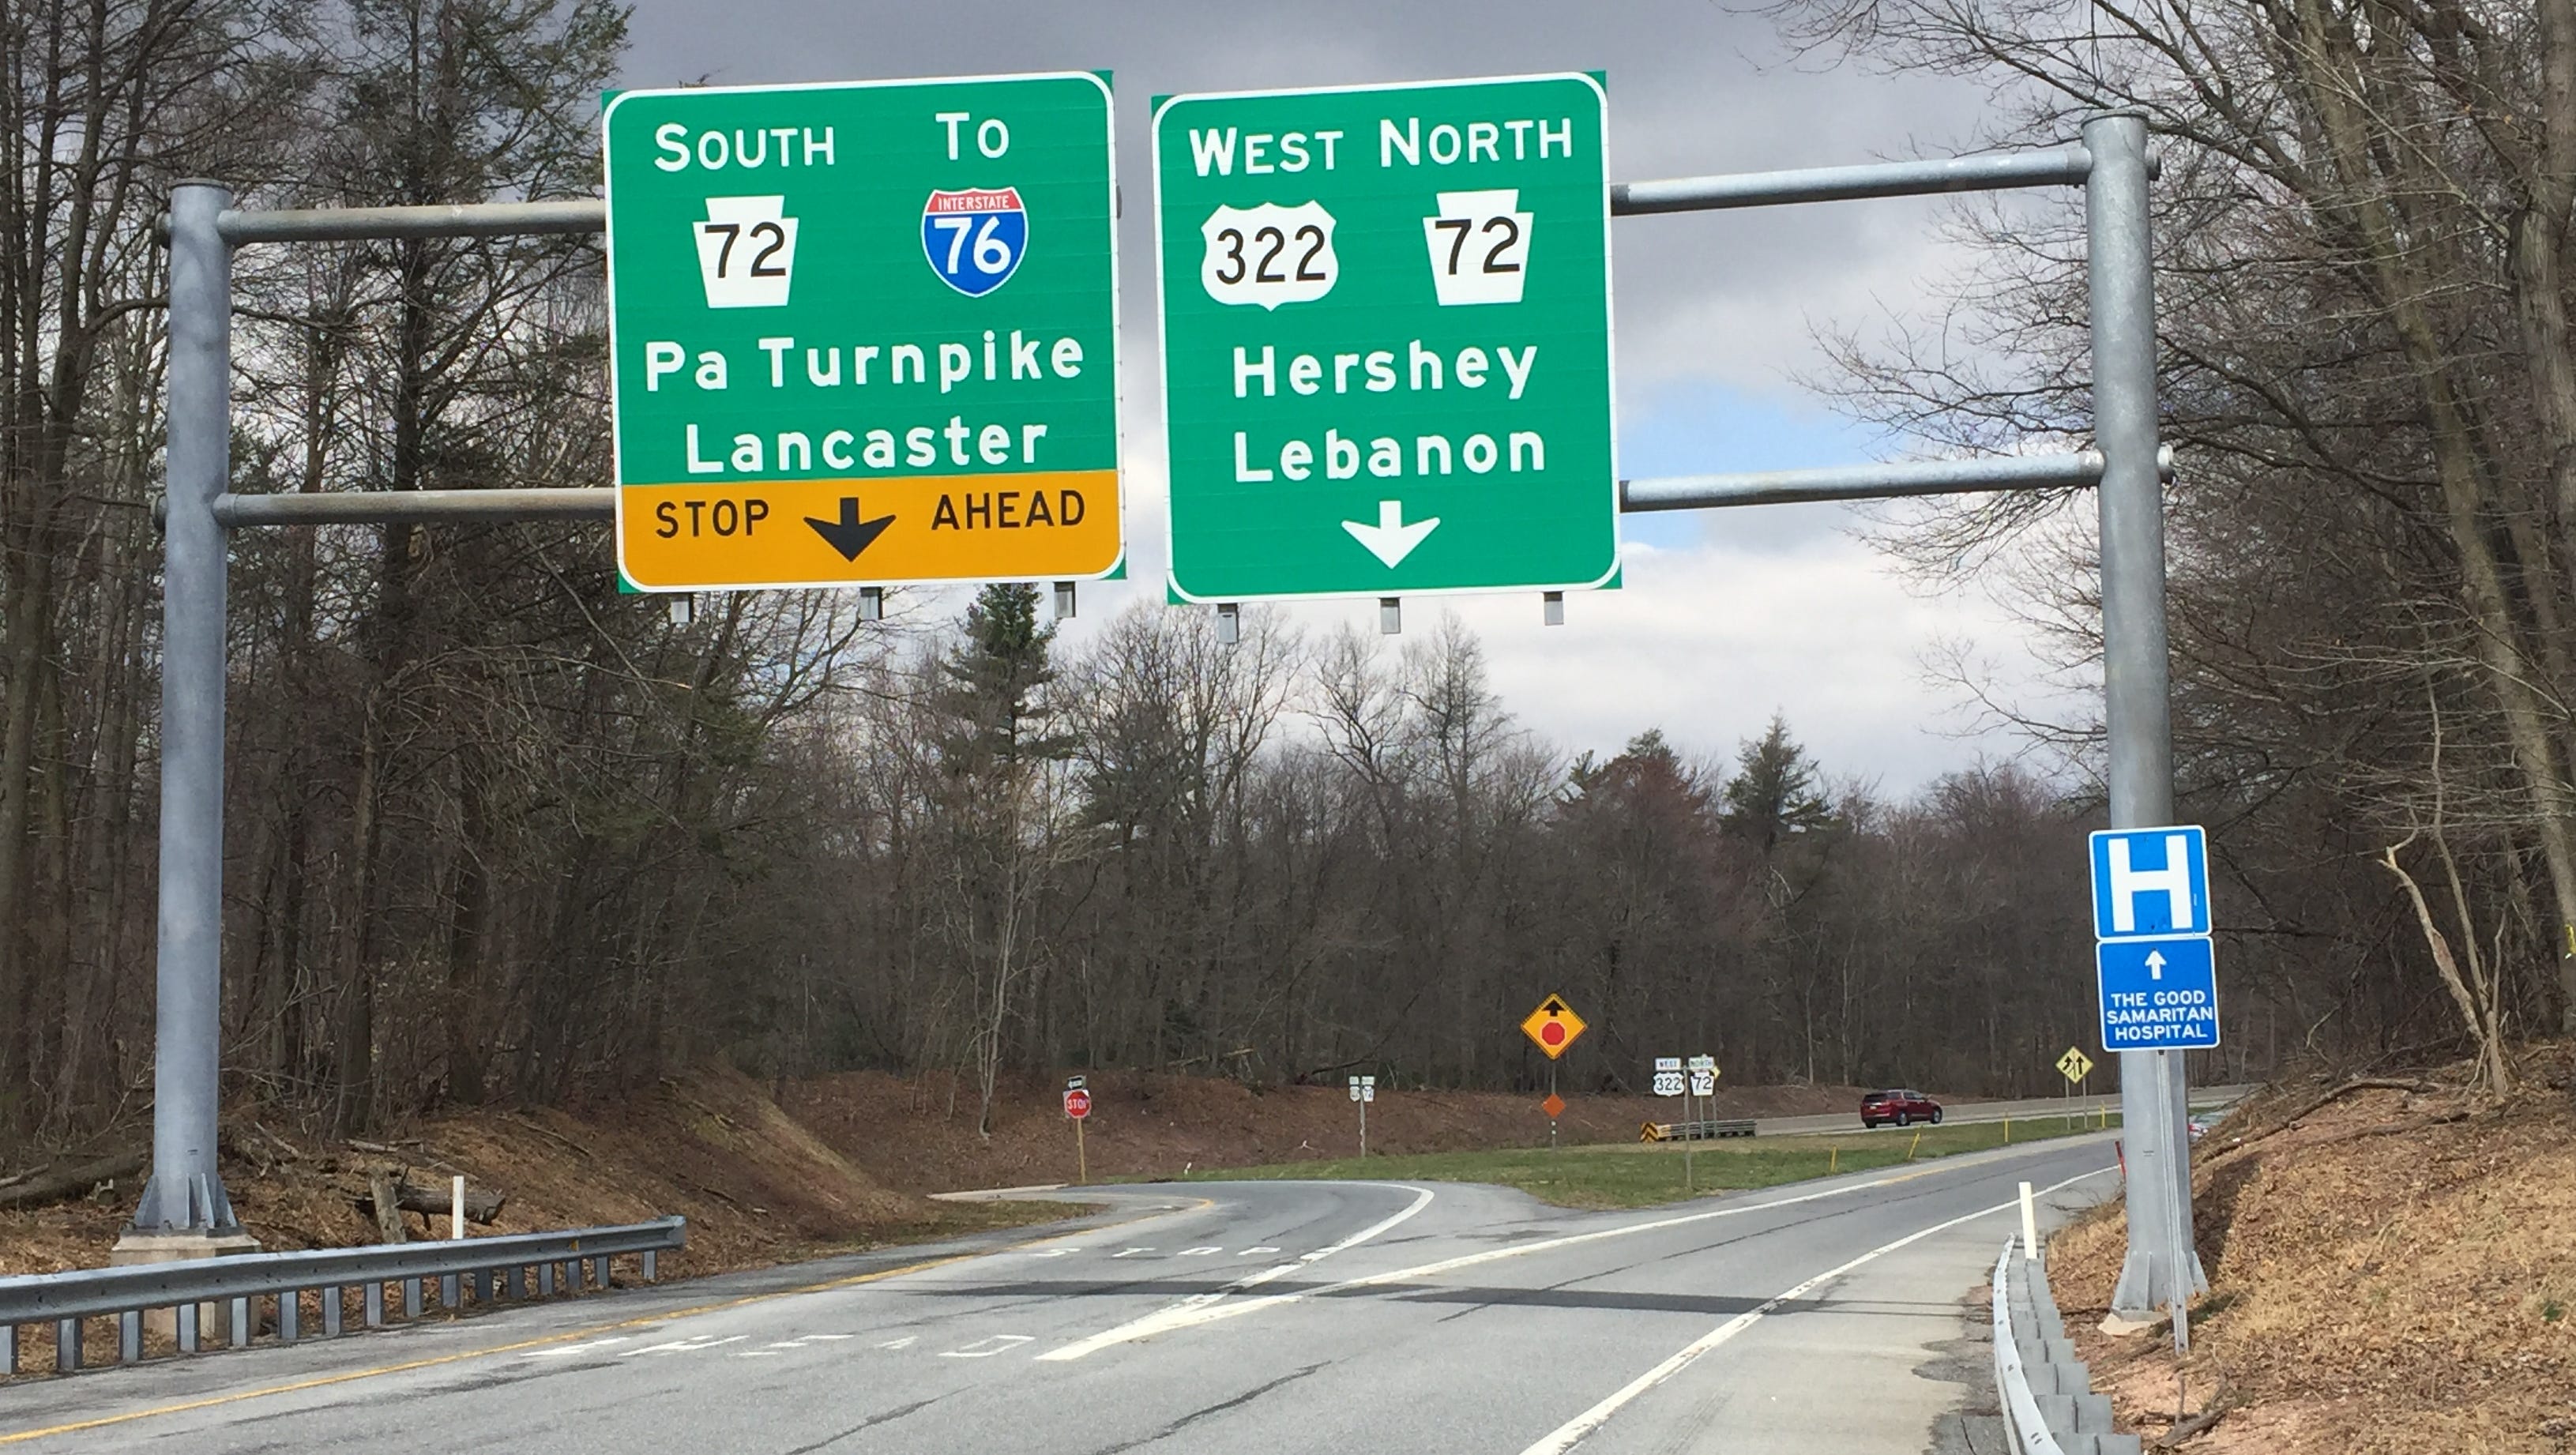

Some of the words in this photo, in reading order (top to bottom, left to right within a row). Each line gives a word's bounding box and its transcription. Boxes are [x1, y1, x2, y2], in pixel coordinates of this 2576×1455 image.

[654, 122, 835, 172] SOUTH
[1189, 126, 1344, 178] WEST
[1379, 117, 1572, 167] NORTH
[938, 195, 1010, 211] INTERSTATE
[704, 221, 787, 279] 72
[934, 216, 1011, 274] 76
[1216, 224, 1326, 285] 322
[1435, 216, 1520, 276] 72
[645, 340, 728, 392] Pa
[758, 330, 1084, 393] Turnpike
[1233, 339, 1537, 400] Hershey
[686, 415, 1047, 474] Lancaster
[1234, 428, 1545, 483] Lebanon
[656, 498, 769, 539] STOP
[931, 489, 1085, 531] AHEAD
[2108, 834, 2193, 932] H
[2107, 1006, 2213, 1025] SAMARITAN
[2111, 992, 2148, 1008] THE
[2153, 990, 2206, 1006] GOOD
[2115, 1024, 2209, 1041] HOSPITAL
[1067, 1099, 1087, 1109] STOP
[1656, 1077, 1681, 1091] 322
[1693, 1076, 1712, 1089] 72
